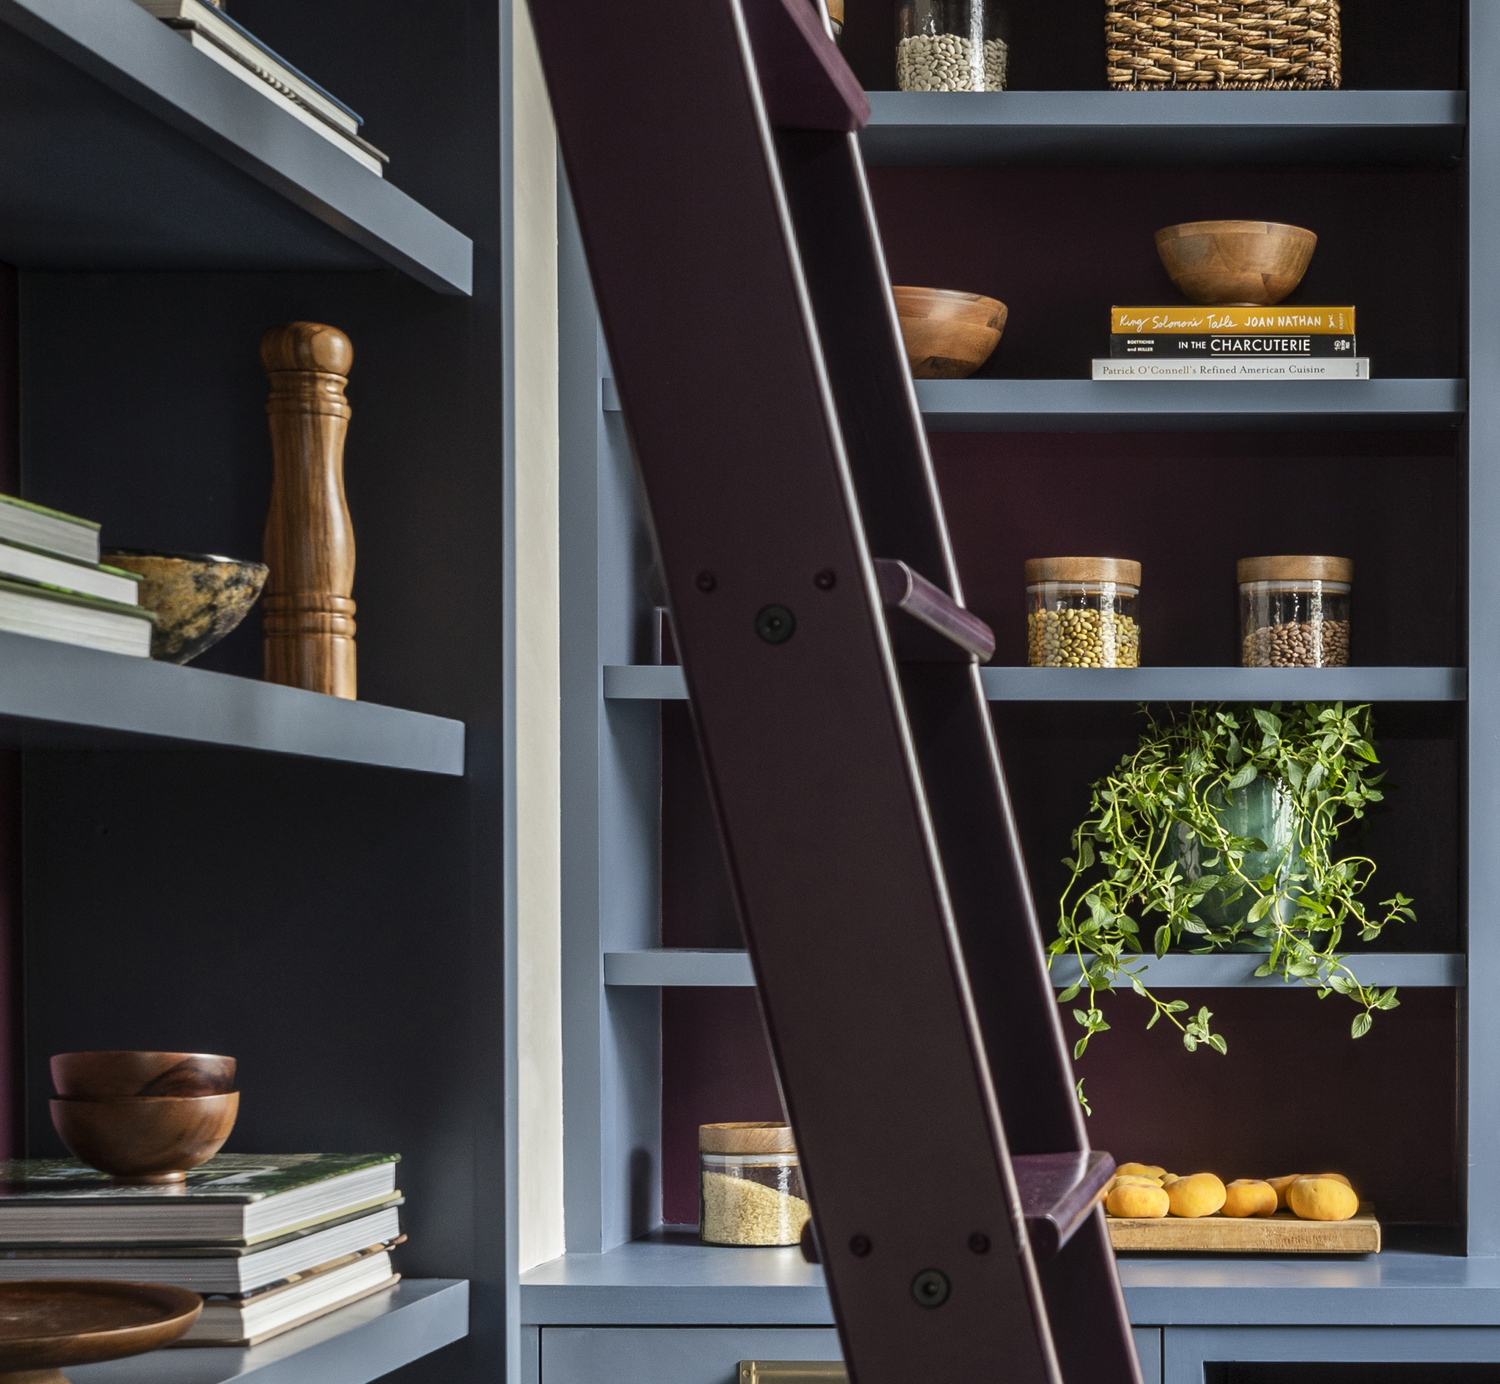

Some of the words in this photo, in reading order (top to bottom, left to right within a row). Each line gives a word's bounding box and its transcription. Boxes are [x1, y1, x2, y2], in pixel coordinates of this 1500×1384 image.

[1119, 314, 1151, 333] King
[1152, 314, 1204, 329] Solomon's
[1206, 313, 1238, 329] Table
[1244, 316, 1274, 328] JOAN
[1277, 315, 1321, 327] NATHAN
[1178, 341, 1189, 349] IN
[1190, 341, 1207, 349] THE
[1210, 339, 1311, 352] CHARCUTERIE
[1102, 365, 1135, 375] Patrick
[1137, 365, 1197, 375] O'Connell's
[1199, 365, 1237, 374] Refined
[1239, 365, 1286, 374] American
[1288, 364, 1326, 374] Cuisine
